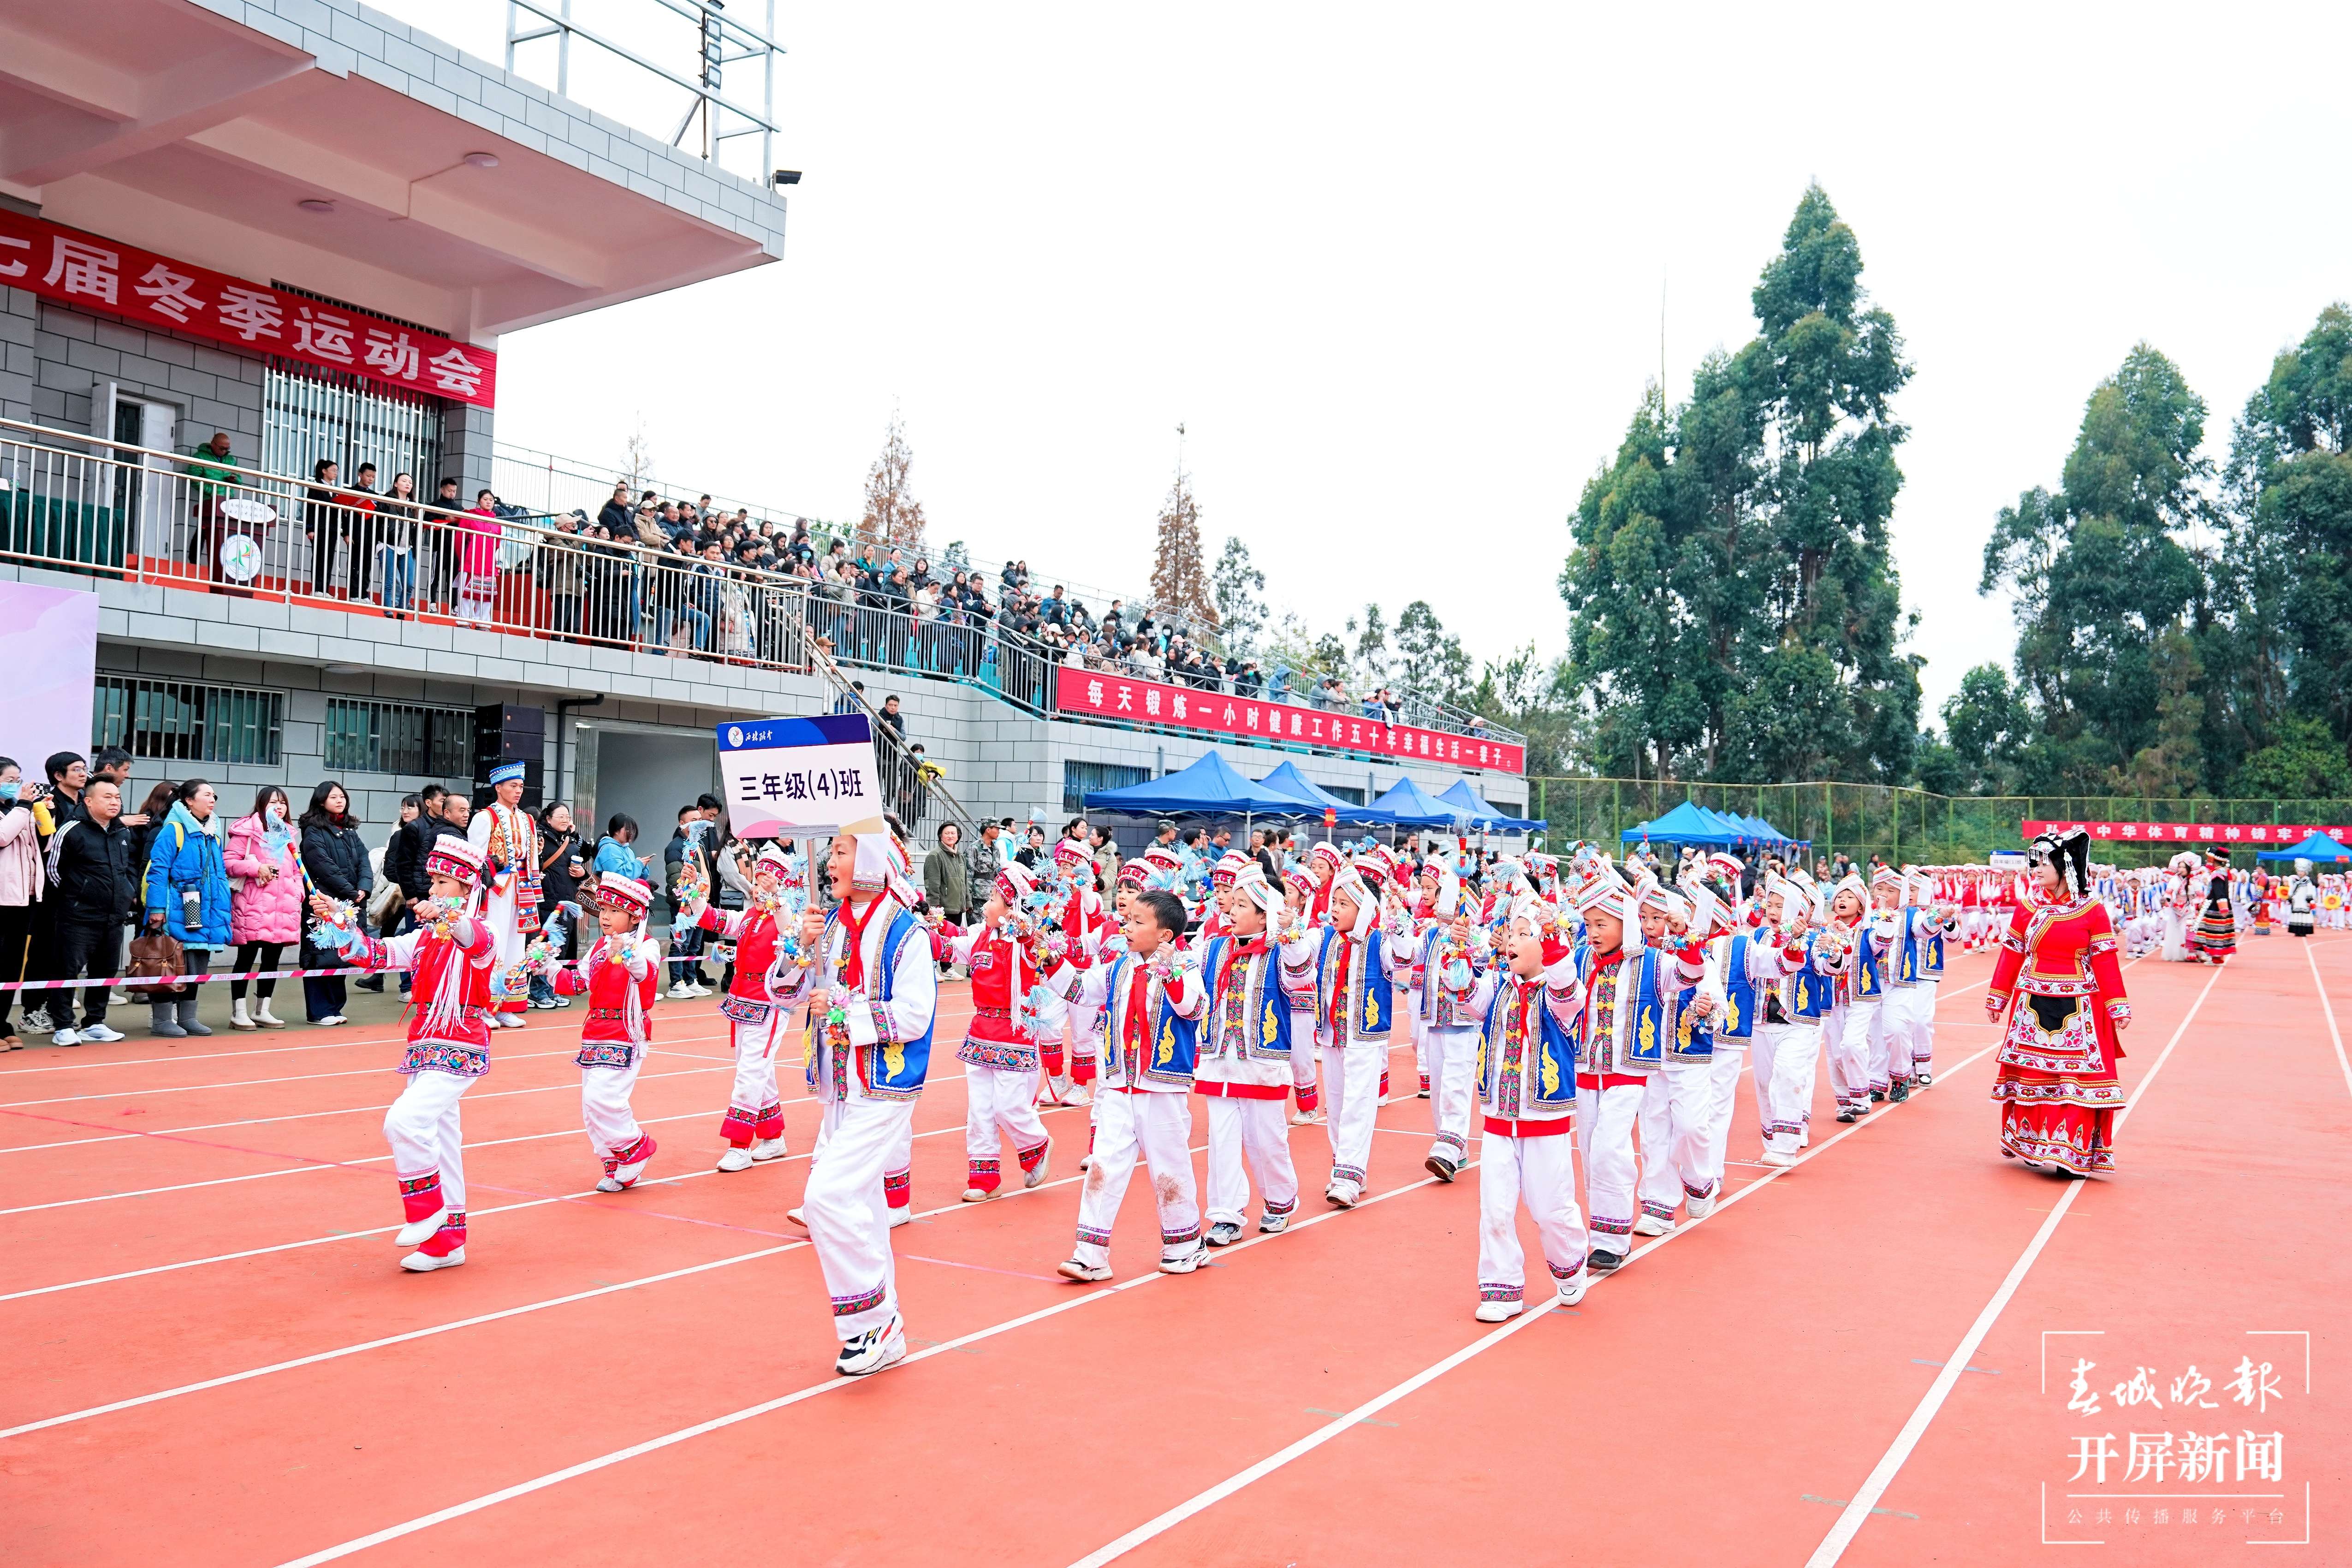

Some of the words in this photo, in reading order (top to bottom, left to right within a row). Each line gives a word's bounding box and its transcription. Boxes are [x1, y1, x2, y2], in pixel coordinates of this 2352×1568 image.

[740, 768, 863, 801] 三年级(4)班
[577, 891, 601, 912] STRON
